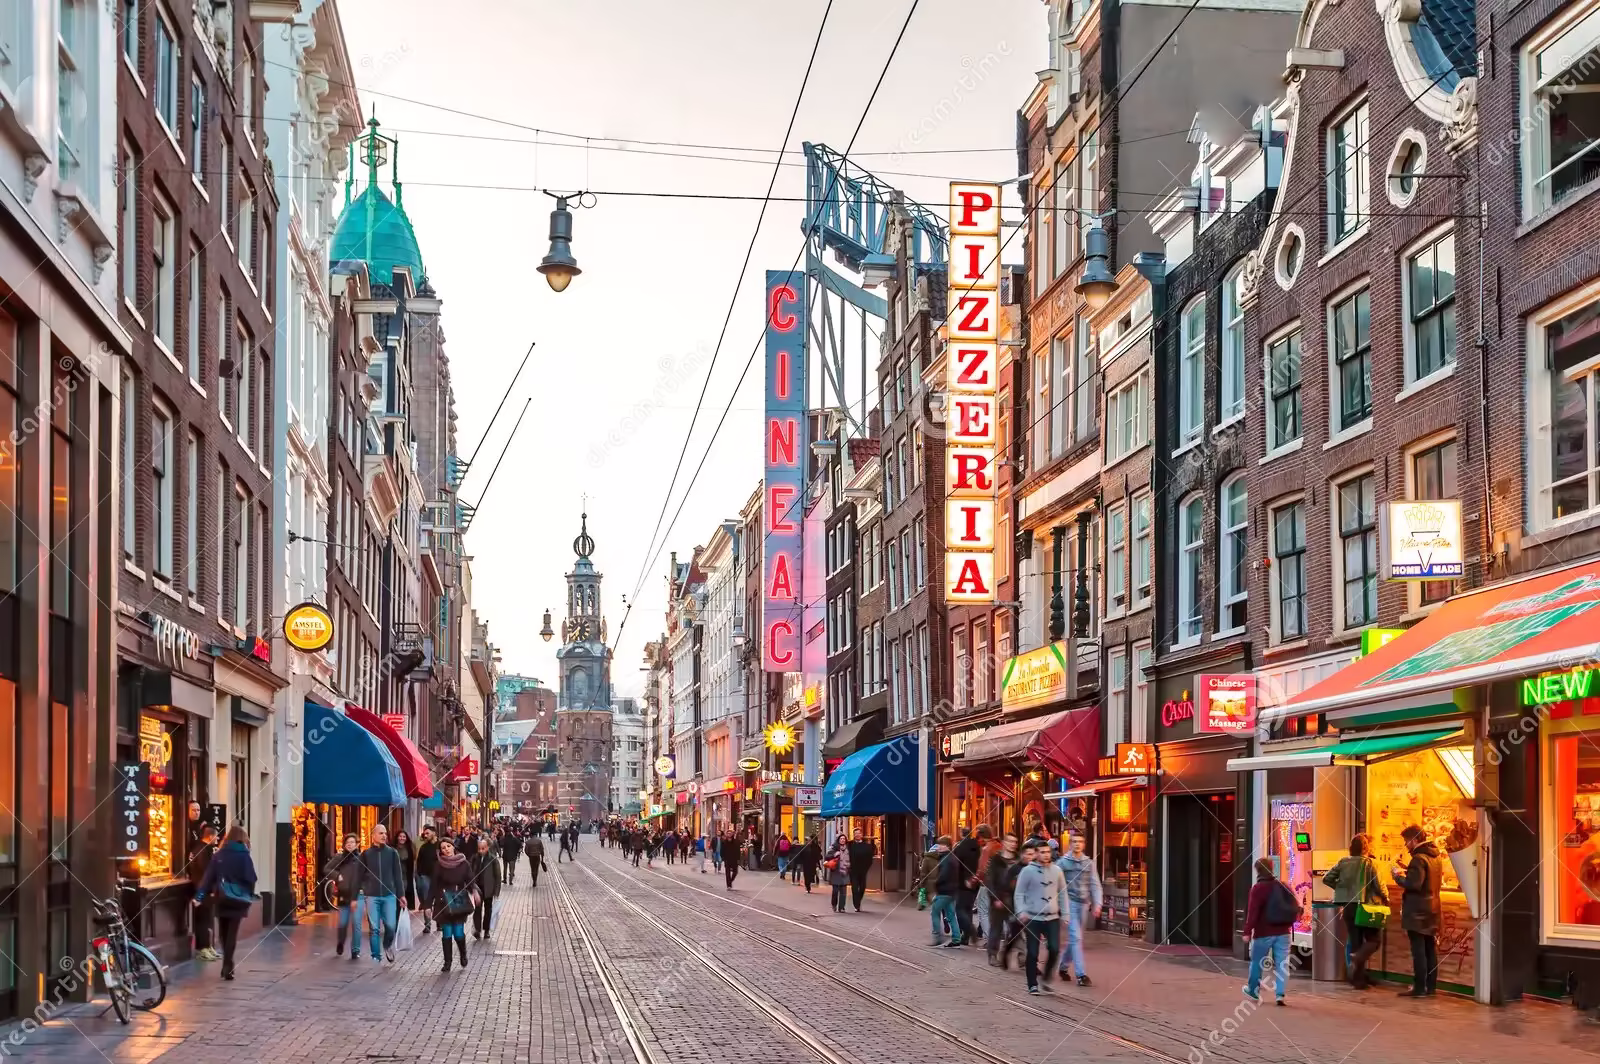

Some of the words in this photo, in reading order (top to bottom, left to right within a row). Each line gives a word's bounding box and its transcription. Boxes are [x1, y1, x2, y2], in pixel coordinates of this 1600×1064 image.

[952, 191, 993, 593] PIZZERIA
[770, 286, 797, 664] CINEAC
[1392, 565, 1421, 575] HOME
[1432, 564, 1462, 574] MADE
[293, 621, 323, 629] AMSTEL
[155, 613, 199, 673] TATTOO
[1209, 678, 1246, 687] Chinese
[1523, 669, 1593, 705] NEW
[1162, 700, 1194, 727] CASIN
[1209, 719, 1247, 729] Massage
[123, 765, 141, 852] TATTOO
[1271, 799, 1311, 825] Massage
